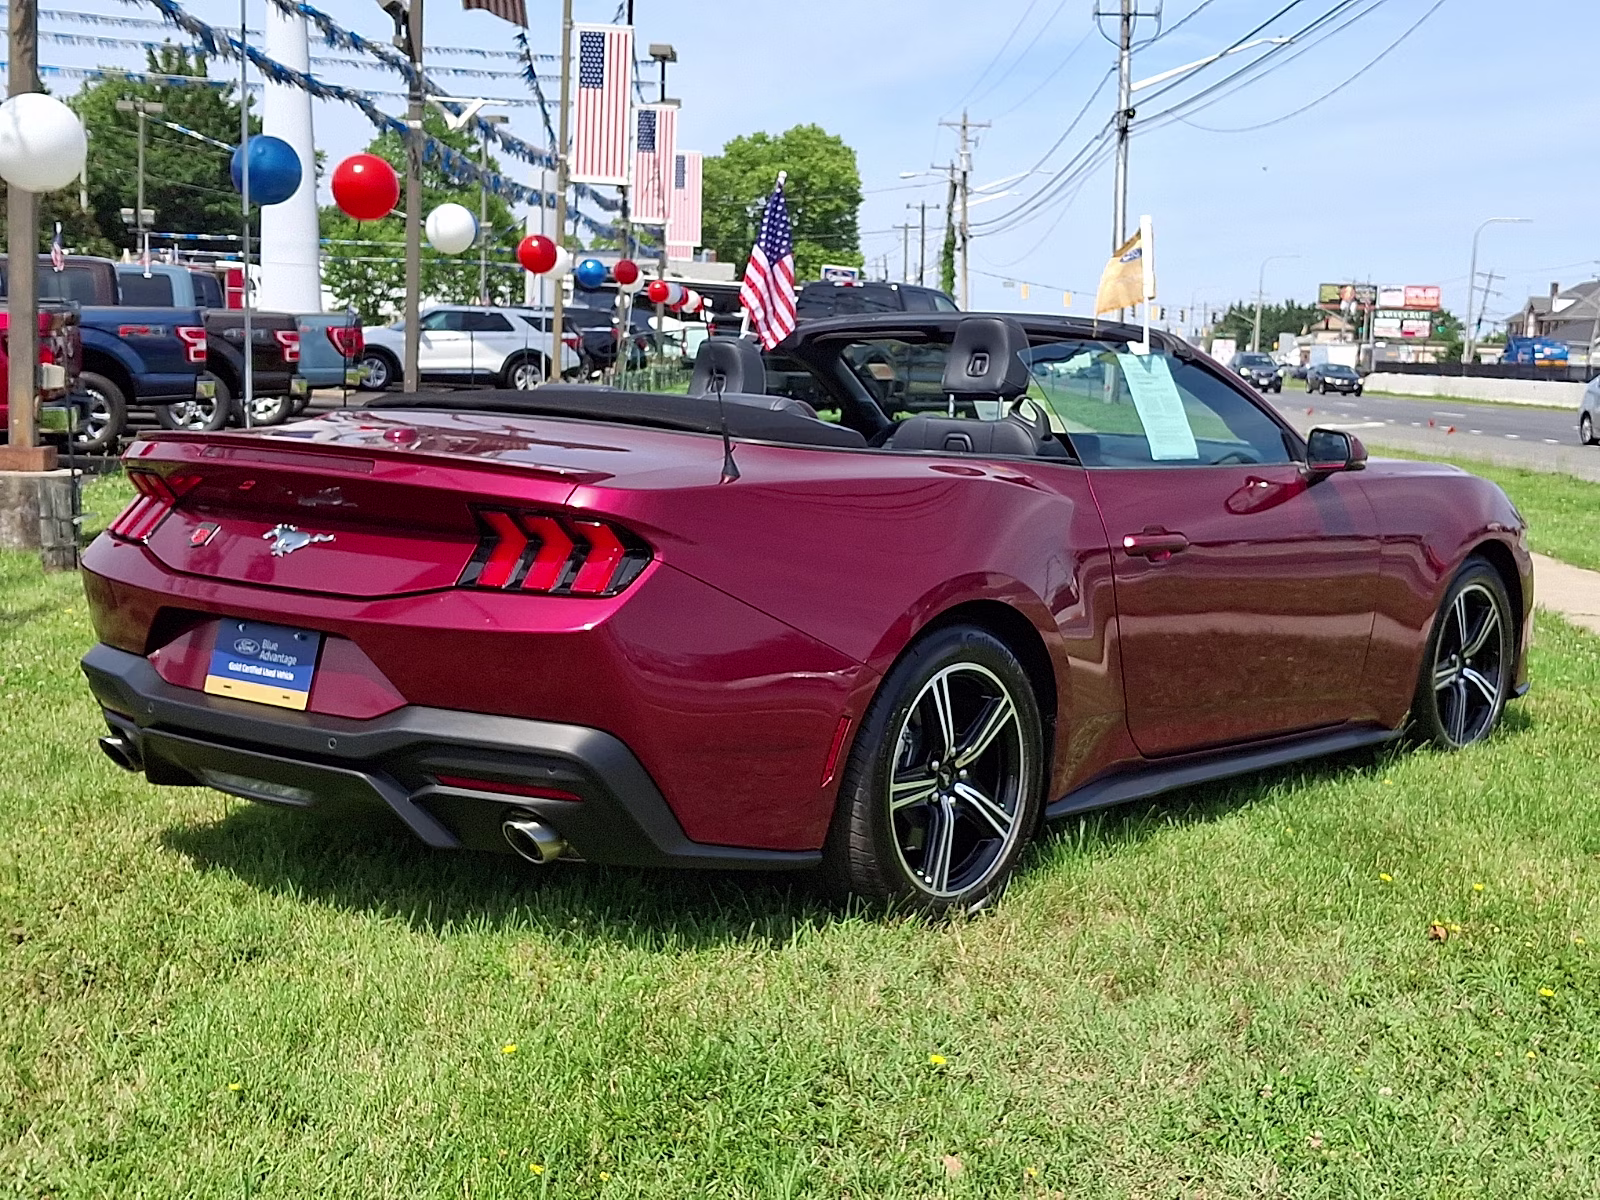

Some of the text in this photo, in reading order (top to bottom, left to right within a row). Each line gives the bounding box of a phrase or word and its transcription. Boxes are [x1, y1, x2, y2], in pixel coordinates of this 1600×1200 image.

[262, 639, 279, 652] Blue
[260, 650, 298, 667] Advantage
[228, 661, 242, 672] Gold
